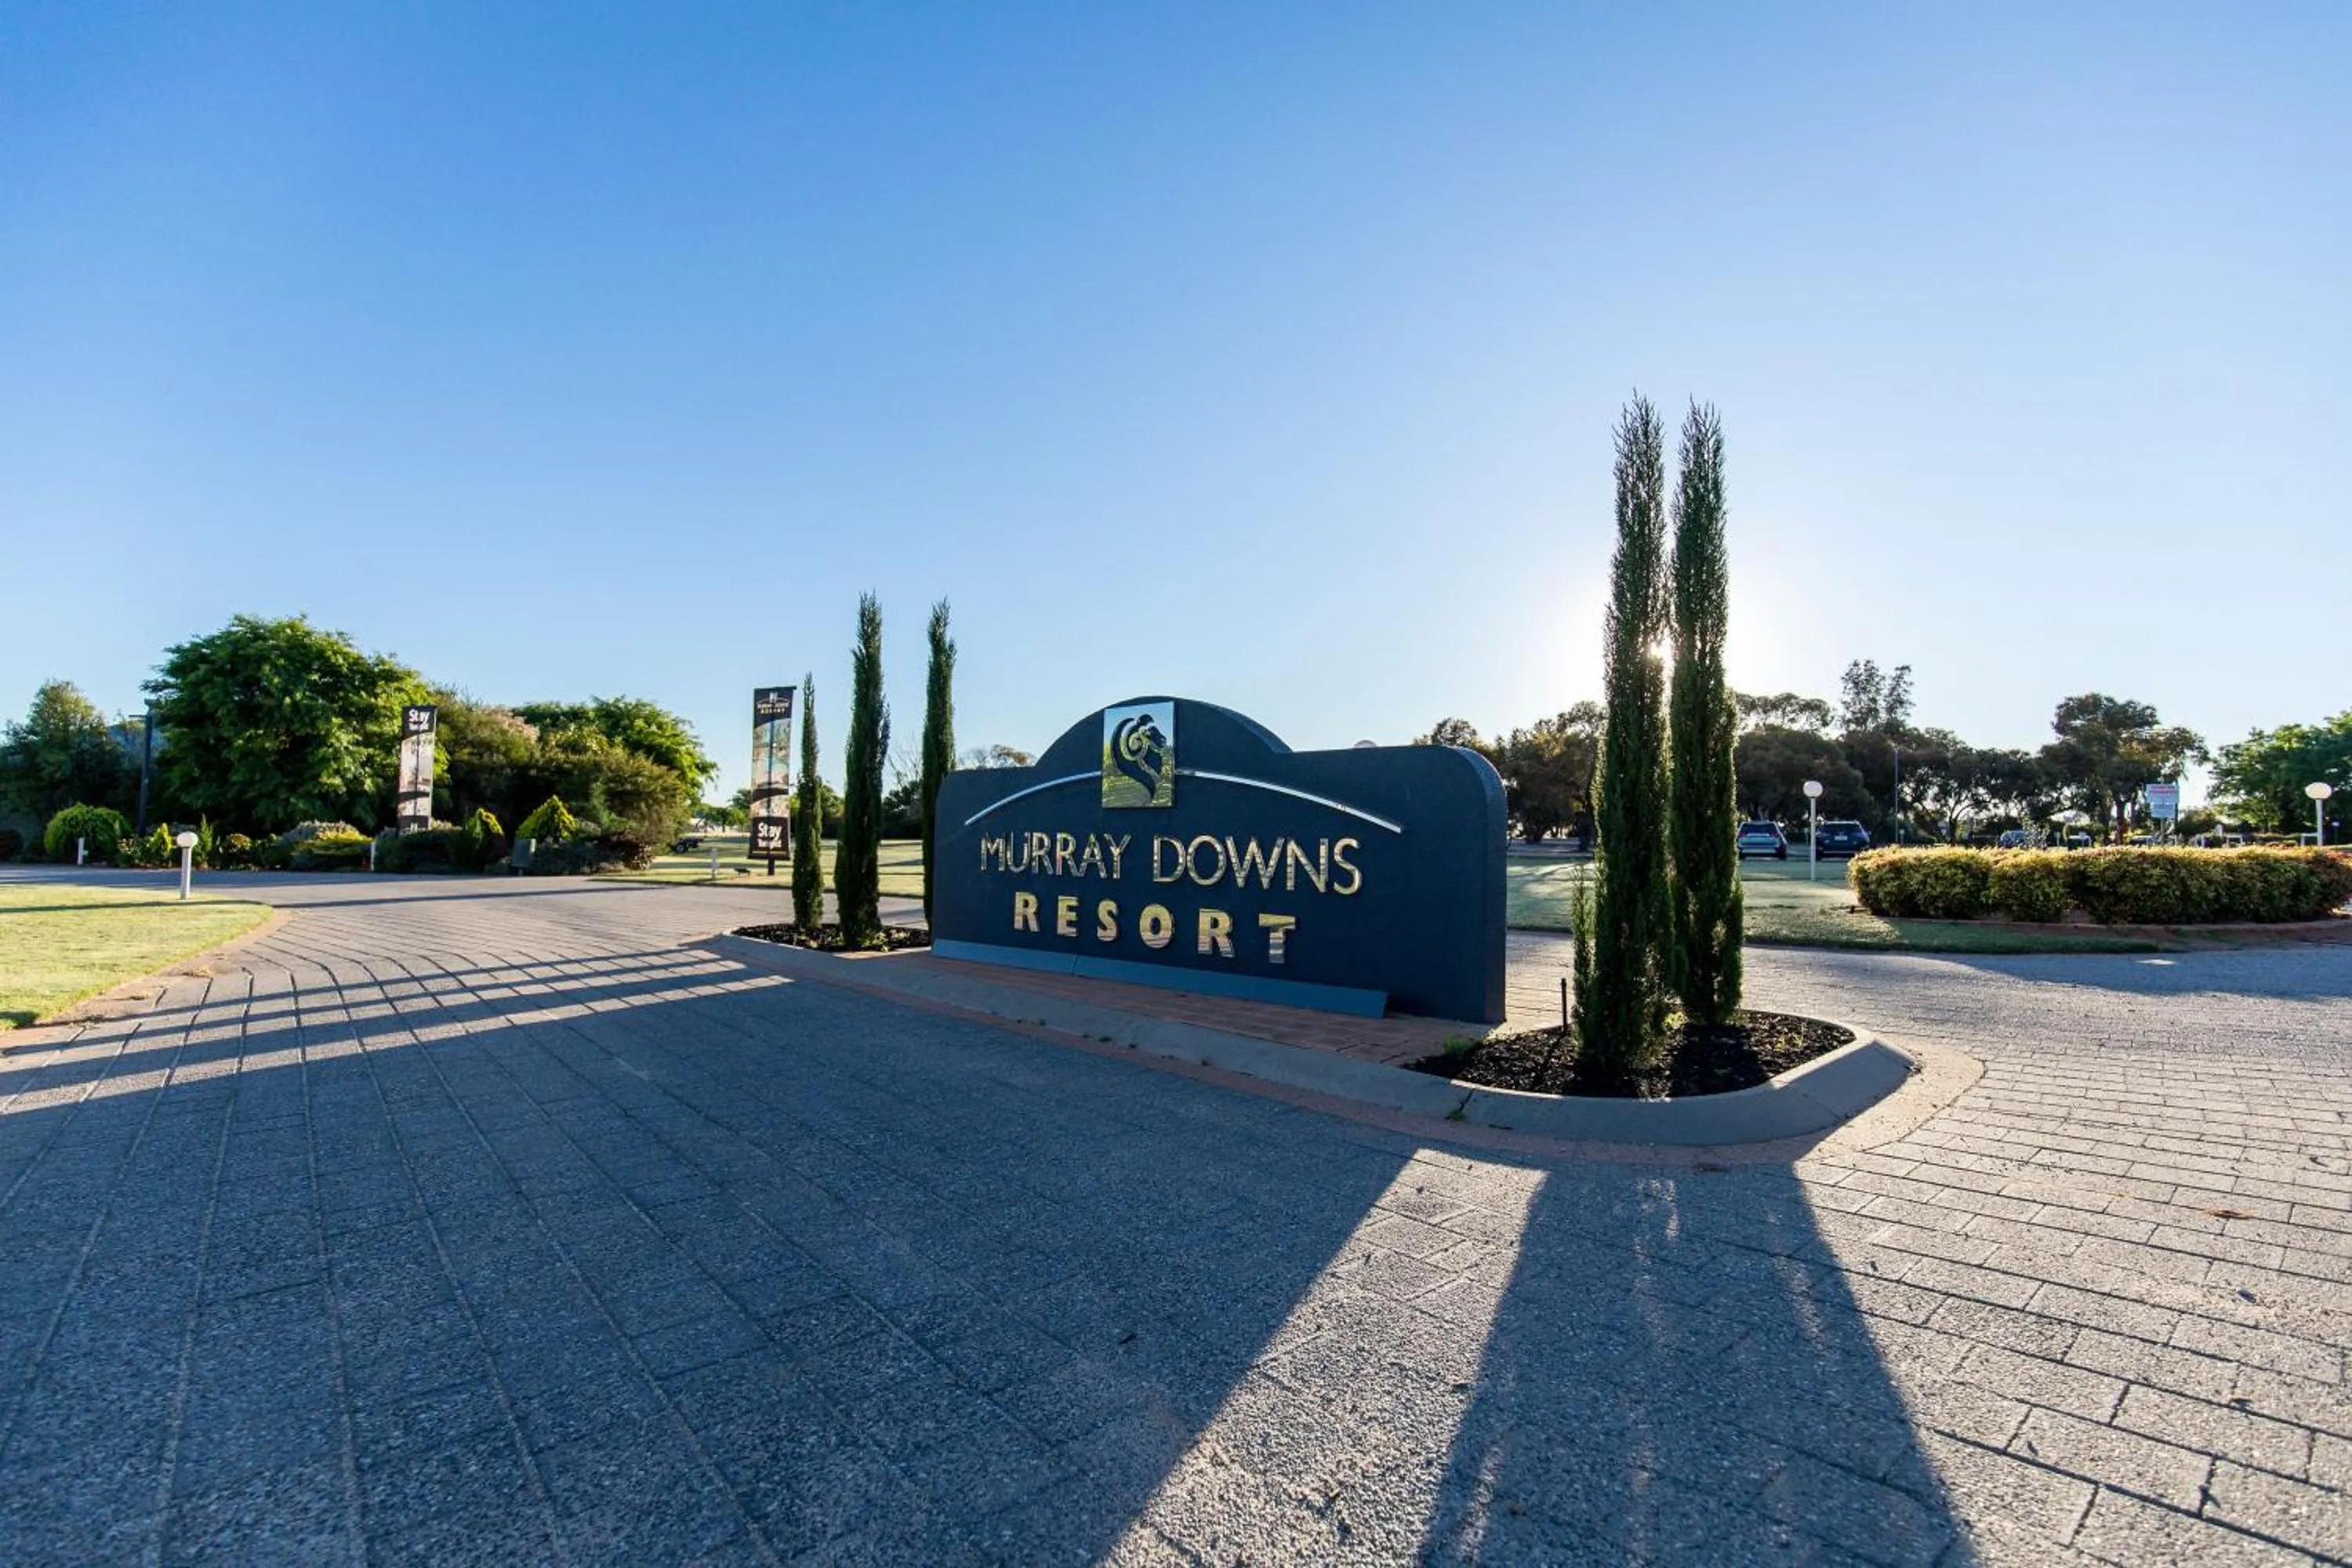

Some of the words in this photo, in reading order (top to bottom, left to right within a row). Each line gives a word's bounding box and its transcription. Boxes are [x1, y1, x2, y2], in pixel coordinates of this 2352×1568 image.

[408, 709, 430, 725] Stay
[758, 822, 782, 841] Stay
[980, 831, 1131, 879] MURRAY
[1153, 835, 1363, 895] DOWNS
[1014, 891, 1296, 964] RESORT
